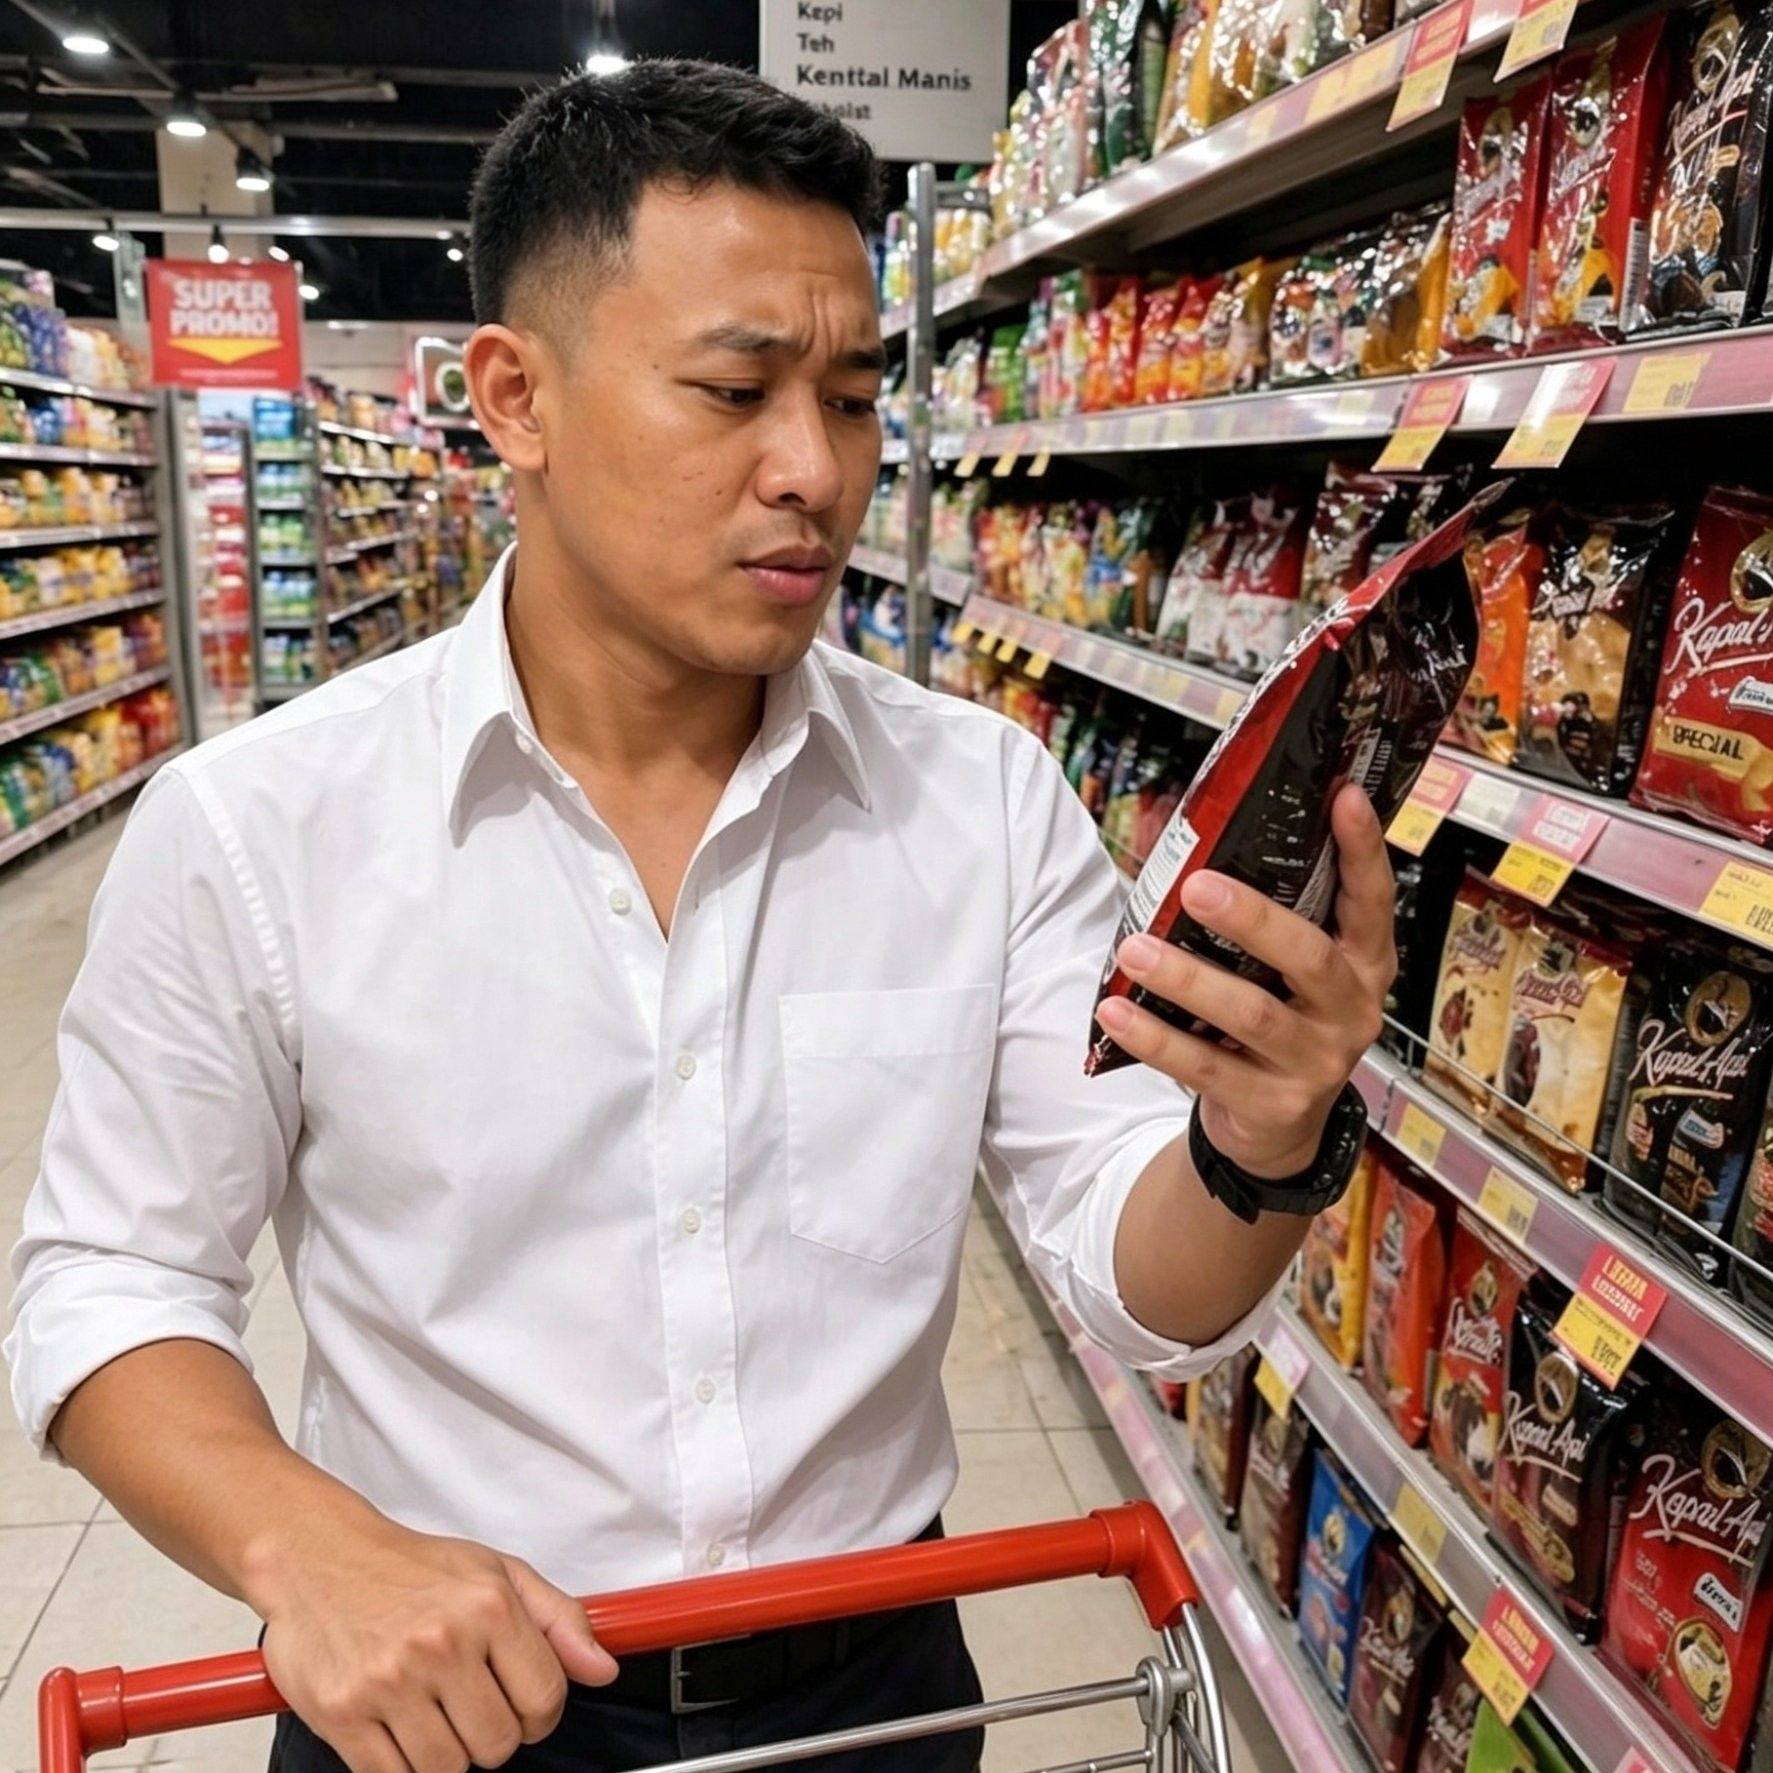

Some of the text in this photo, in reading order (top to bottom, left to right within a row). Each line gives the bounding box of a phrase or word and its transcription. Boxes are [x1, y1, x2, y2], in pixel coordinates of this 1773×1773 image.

[797, 33, 835, 52] Teh
[897, 69, 972, 91] Manis
[173, 279, 272, 310] SUPER
[169, 309, 279, 337] PROMO!
